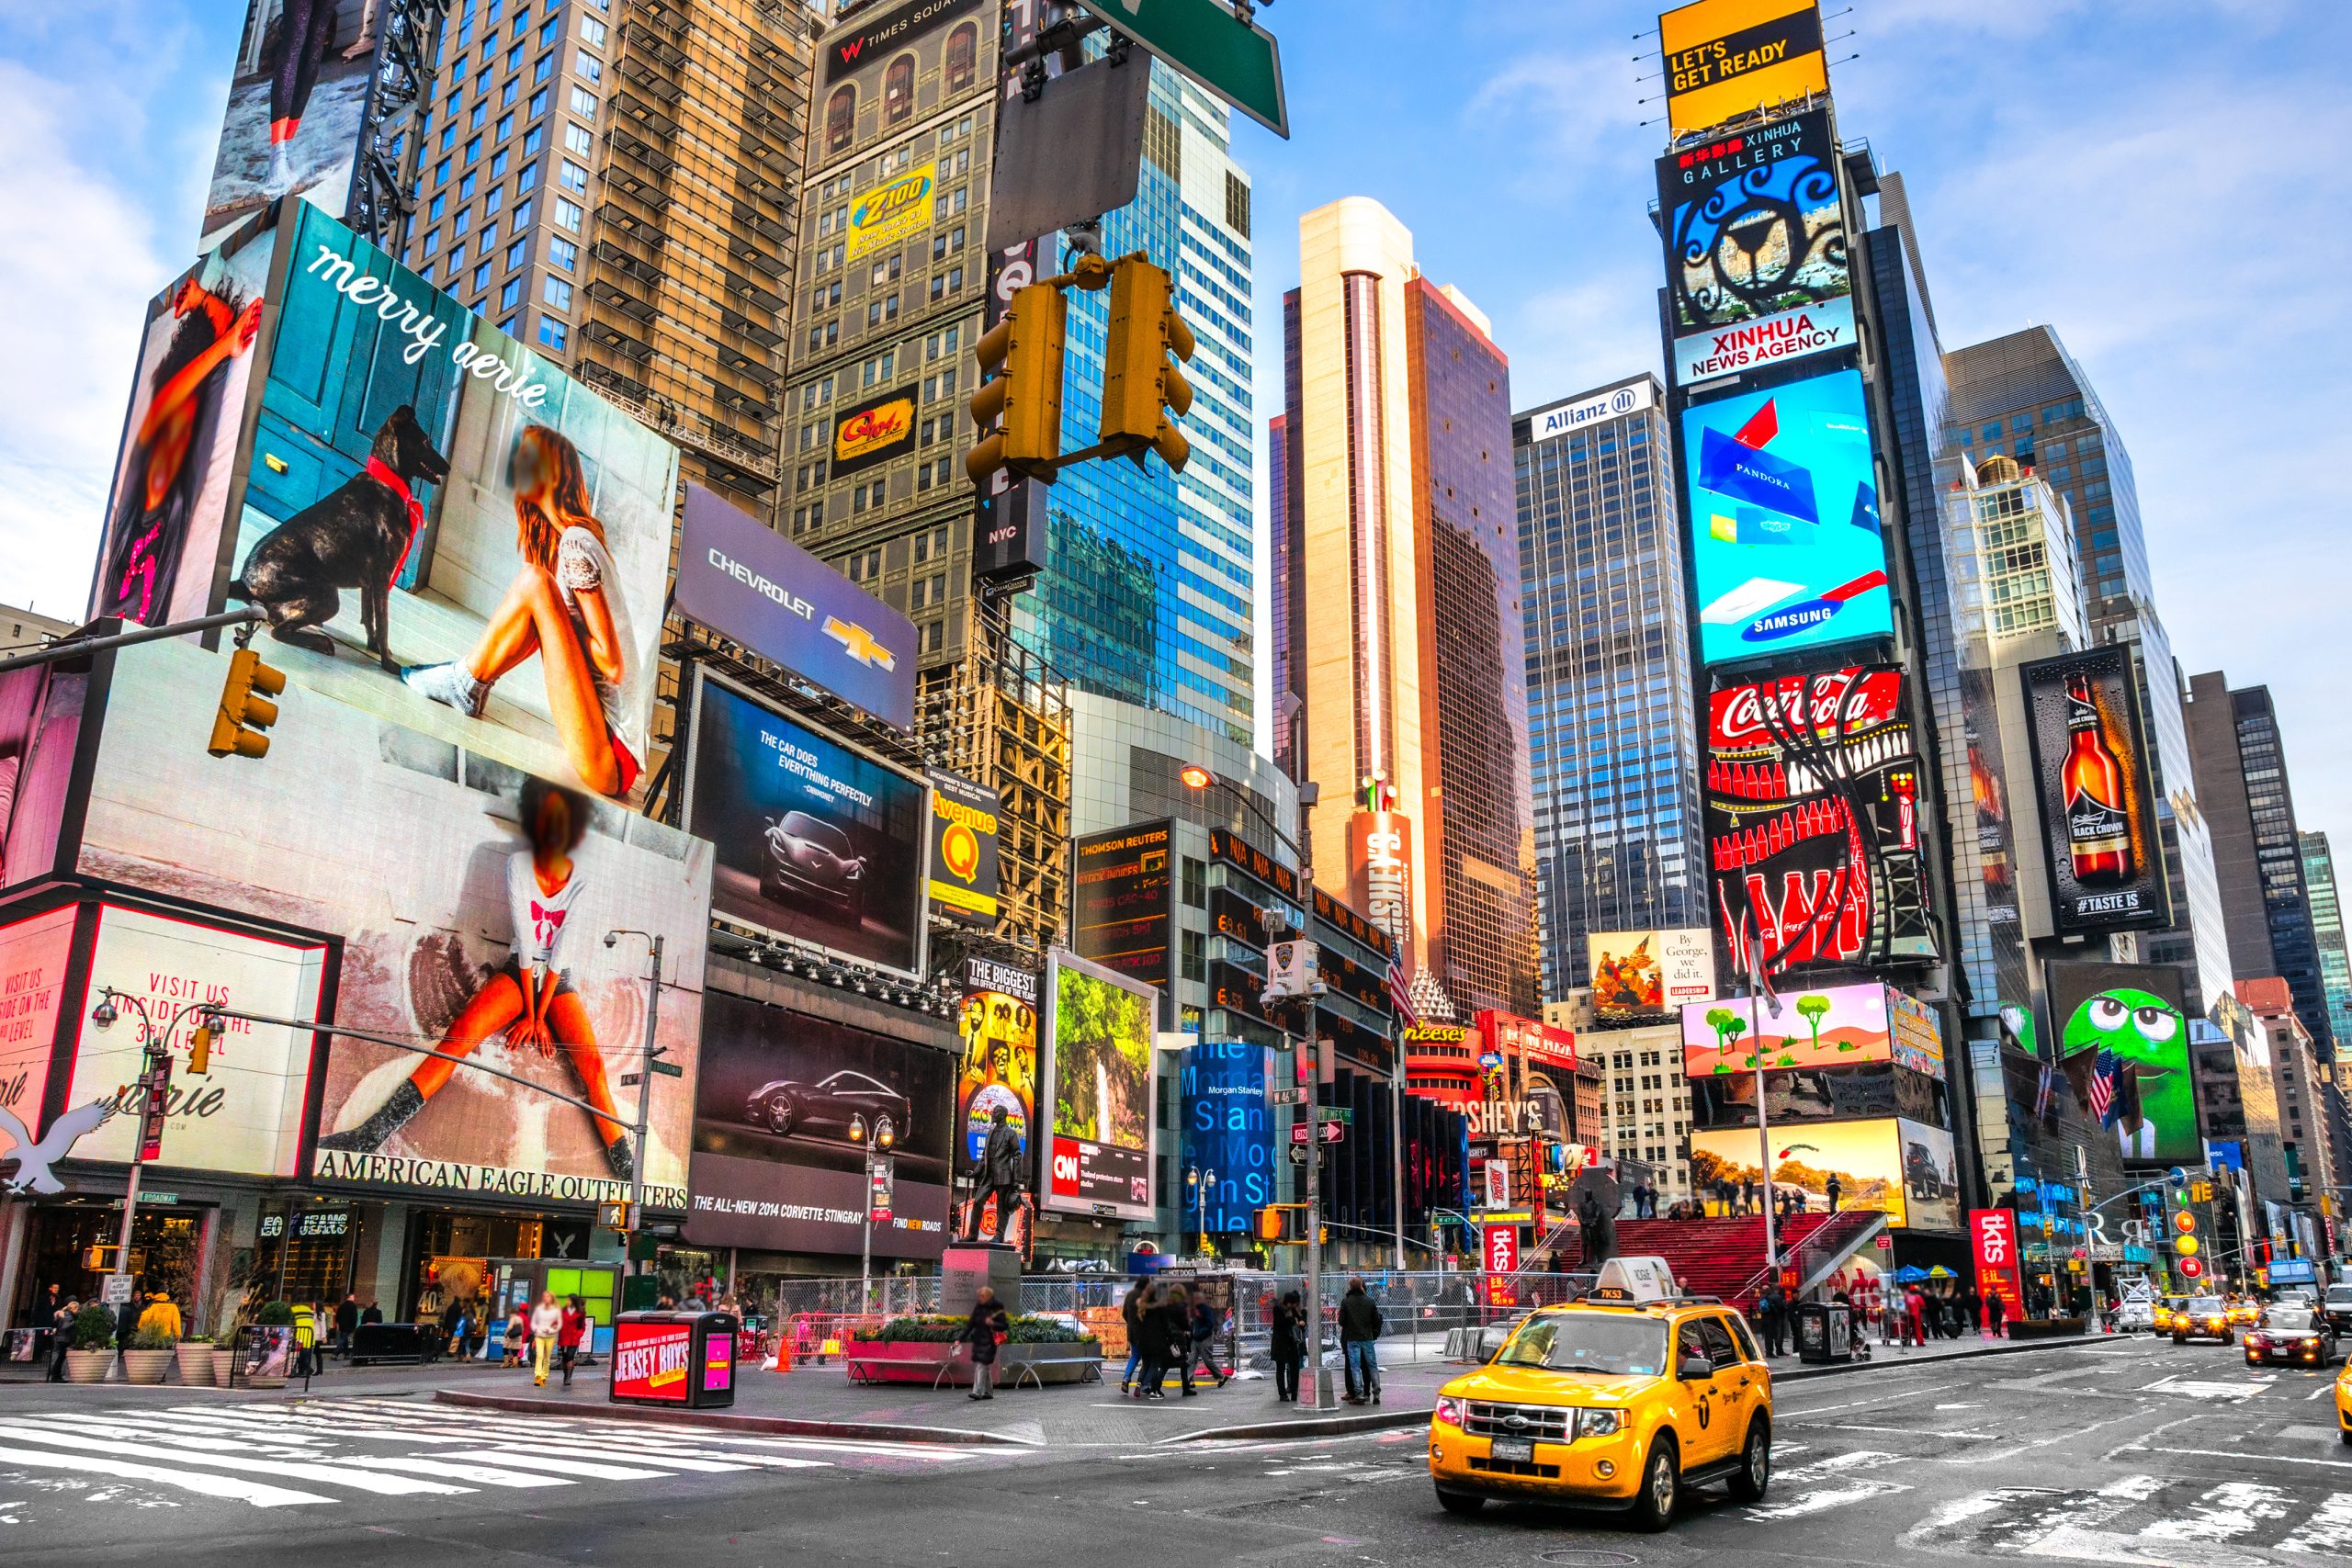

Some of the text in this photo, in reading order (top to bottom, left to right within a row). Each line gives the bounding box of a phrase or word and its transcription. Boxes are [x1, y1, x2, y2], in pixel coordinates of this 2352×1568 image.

[841, 37, 865, 63] W
[867, 18, 908, 47] TIMES
[1671, 41, 1727, 73] LET'S
[1673, 39, 1787, 92] GET READY
[1746, 121, 1802, 148] XINHUA
[1683, 138, 1802, 184] GALLERY
[860, 176, 924, 231] Z100
[852, 219, 929, 257] Hit Music Station
[858, 231, 879, 245] New
[307, 245, 443, 365] merry
[1713, 314, 1815, 355] XINHUA
[1692, 327, 1840, 377] NEWS AGENCY
[452, 336, 547, 409] aerie
[1545, 401, 1608, 433] Allianz
[1736, 463, 1792, 491] PANDORA
[989, 526, 1018, 545] NYC
[707, 547, 815, 621] CHEVROLET
[1754, 607, 1832, 634] SAMSUNG
[760, 730, 819, 768] THE CAR DOES
[778, 755, 873, 807] EVERYTHING PERFECTLY
[944, 783, 982, 802] BEST MUSICAL
[2074, 825, 2096, 837] BLACK
[2096, 821, 2123, 835] CROWN
[942, 822, 979, 885] Q
[1080, 829, 1168, 858] THOMSON REUTERS
[1230, 835, 1247, 864] N/A
[1254, 851, 1271, 879] N/A
[1275, 864, 1292, 892] N/A
[1316, 891, 1330, 918] N/A
[2076, 896, 2124, 914] #TASTE
[2127, 893, 2139, 907] IS
[1667, 946, 1708, 957] George,
[1679, 934, 1691, 946] By
[6, 968, 42, 995] VISIT US
[969, 976, 979, 987] BOX
[979, 978, 997, 992] OFFICE
[997, 982, 1005, 993] HIT
[1005, 986, 1012, 995] OF
[1012, 987, 1022, 998] THE
[992, 963, 1036, 993] BIGGEST
[1674, 968, 1702, 979] did it.
[18, 990, 51, 1016] ON THE
[150, 973, 230, 1006] VISIT US
[1672, 987, 1706, 995] LEADERSHIP
[8, 1020, 34, 1043] LEVEL
[1208, 1086, 1263, 1097] Morgan Stanley
[1274, 1093, 1279, 1103] W
[1282, 1091, 1290, 1103] 46
[1325, 1109, 1342, 1120] TIMES
[1296, 1126, 1329, 1139] ON AY
[319, 1150, 687, 1209] AMERICAN EAGLE OUTFITERS
[1054, 1154, 1078, 1181] CNN
[142, 1193, 176, 1203] BROADWAY
[695, 1195, 864, 1224] THE ALL-NEW 2014 CORVETTE STINGRAY
[300, 1213, 348, 1235] JEANS
[892, 1217, 942, 1232] FIND NEW ROADS
[2182, 1217, 2191, 1225] m
[1493, 1229, 1512, 1271] tkts
[1981, 1213, 2007, 1264] tkts
[2186, 1263, 2197, 1271] m
[1600, 1288, 1623, 1299] 7K53
[615, 1346, 657, 1382] JERSEY
[659, 1341, 690, 1375] BOYS
